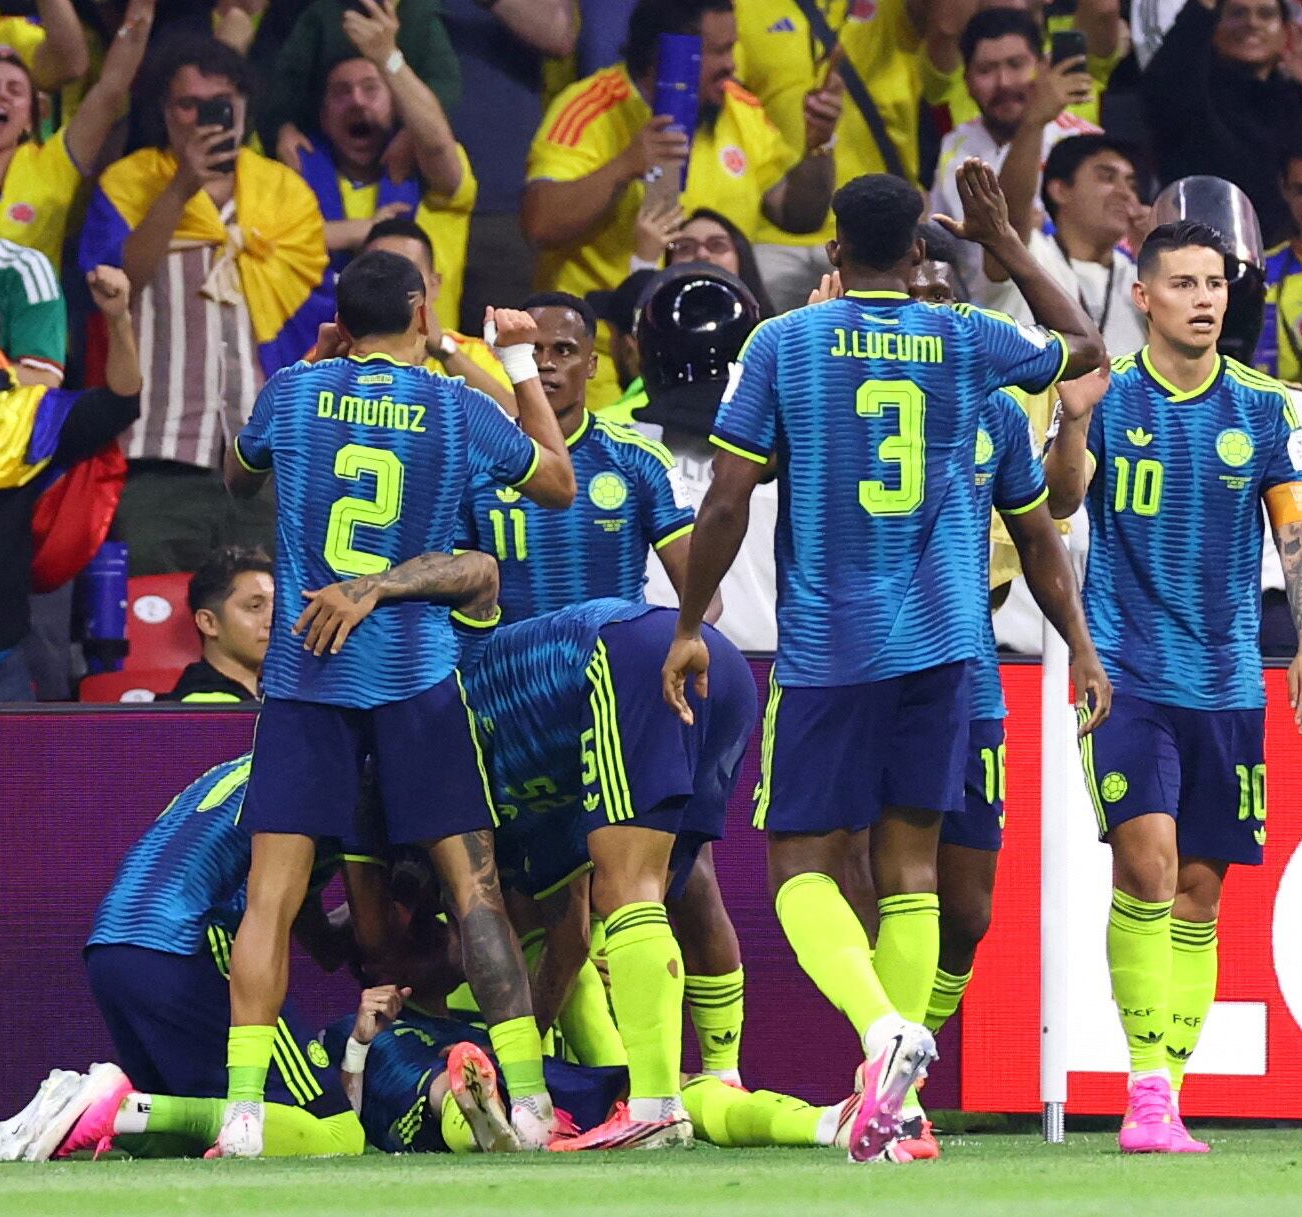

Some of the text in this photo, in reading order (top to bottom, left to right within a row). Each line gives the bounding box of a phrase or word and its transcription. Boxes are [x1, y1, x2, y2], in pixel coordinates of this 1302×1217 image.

[830, 328, 943, 364] J.LUCUMI
[317, 391, 427, 433] D.MUÑOZ
[856, 379, 926, 516] 3
[323, 443, 404, 577] 2
[1114, 456, 1164, 517] 10
[489, 508, 528, 561] 11
[1235, 763, 1267, 821] 10
[1172, 1013, 1201, 1028] FCF
